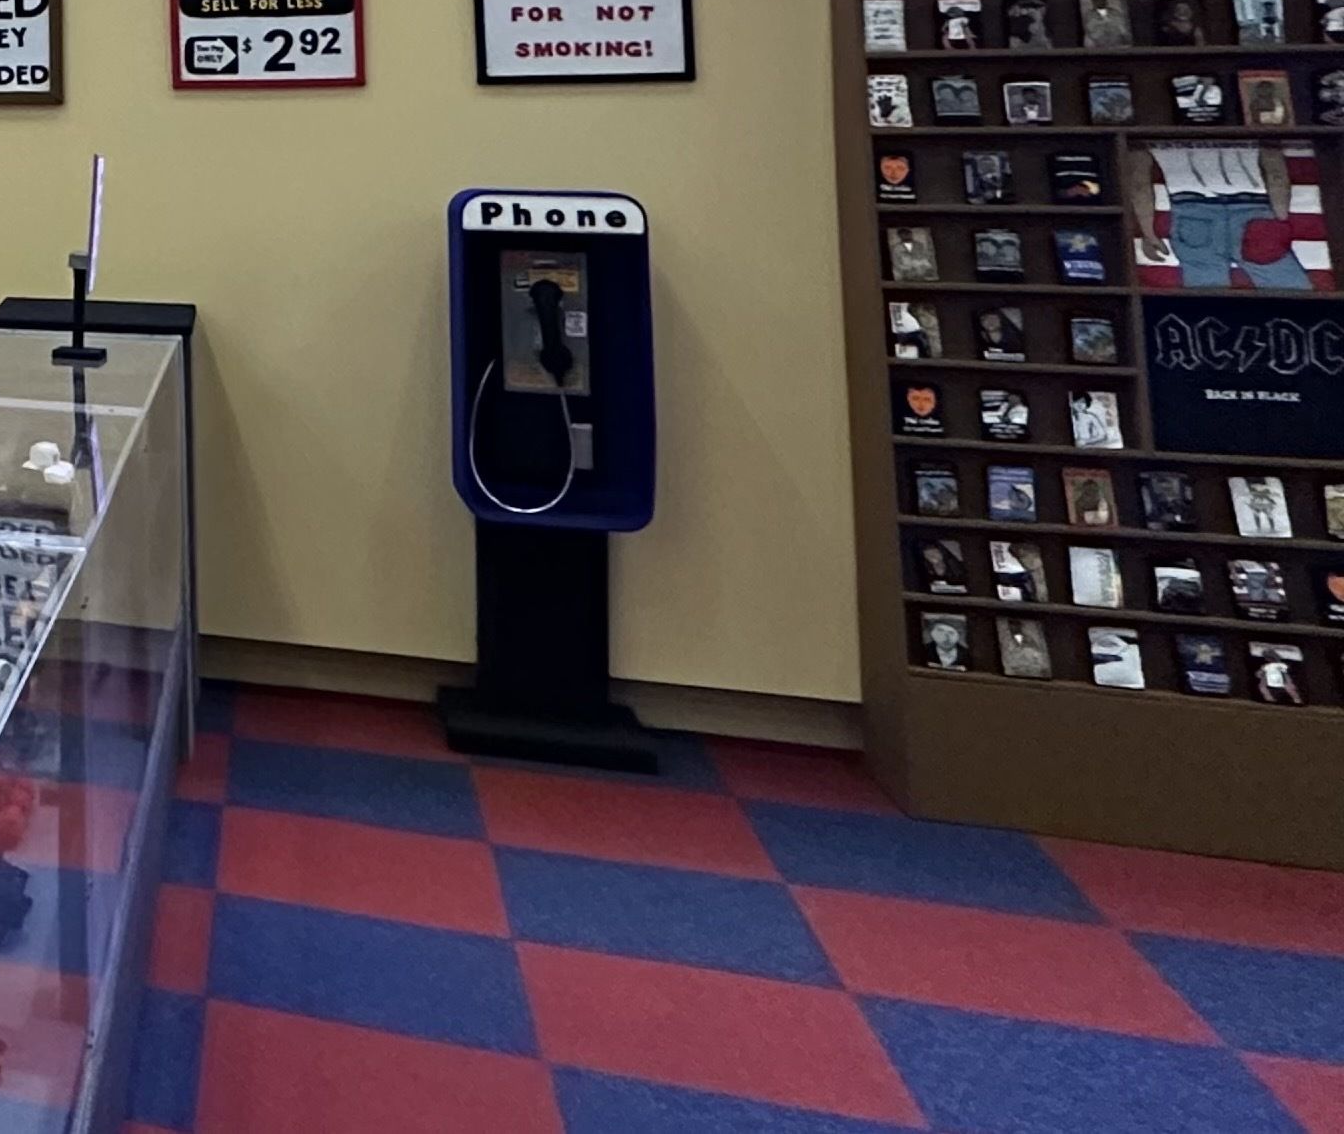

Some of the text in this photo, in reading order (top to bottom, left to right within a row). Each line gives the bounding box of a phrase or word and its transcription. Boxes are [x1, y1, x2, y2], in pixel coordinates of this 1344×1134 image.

[510, 5, 655, 22] FOR NOT
[514, 39, 654, 58] SMOKING!
[480, 201, 628, 229] Phone
